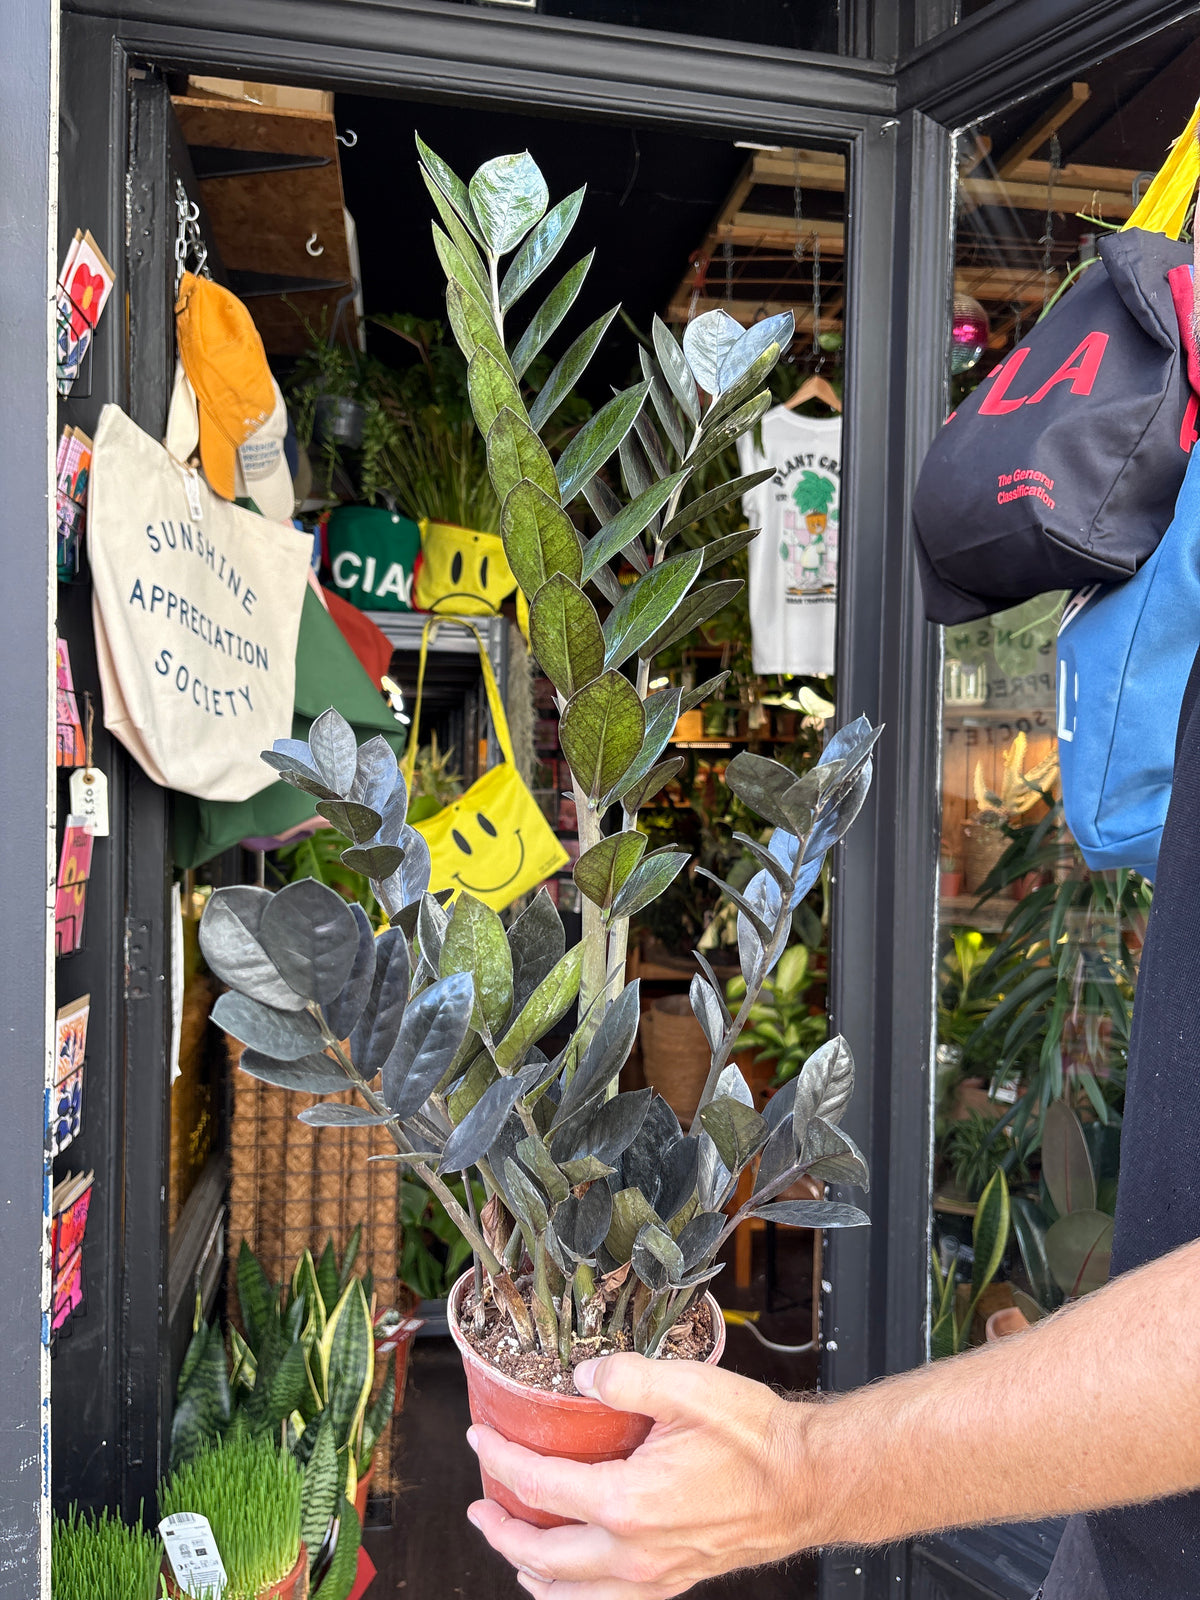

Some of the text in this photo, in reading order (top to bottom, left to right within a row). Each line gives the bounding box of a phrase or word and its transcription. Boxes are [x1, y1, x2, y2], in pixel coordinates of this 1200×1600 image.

[945, 331, 1109, 424] LA
[772, 453, 814, 487] PLANT
[997, 484, 1055, 510] Classification
[998, 469, 1054, 490] The General
[146, 519, 257, 616] SUNSHINE
[129, 578, 269, 672] APPRECIATION
[155, 649, 255, 718] SOCIETY
